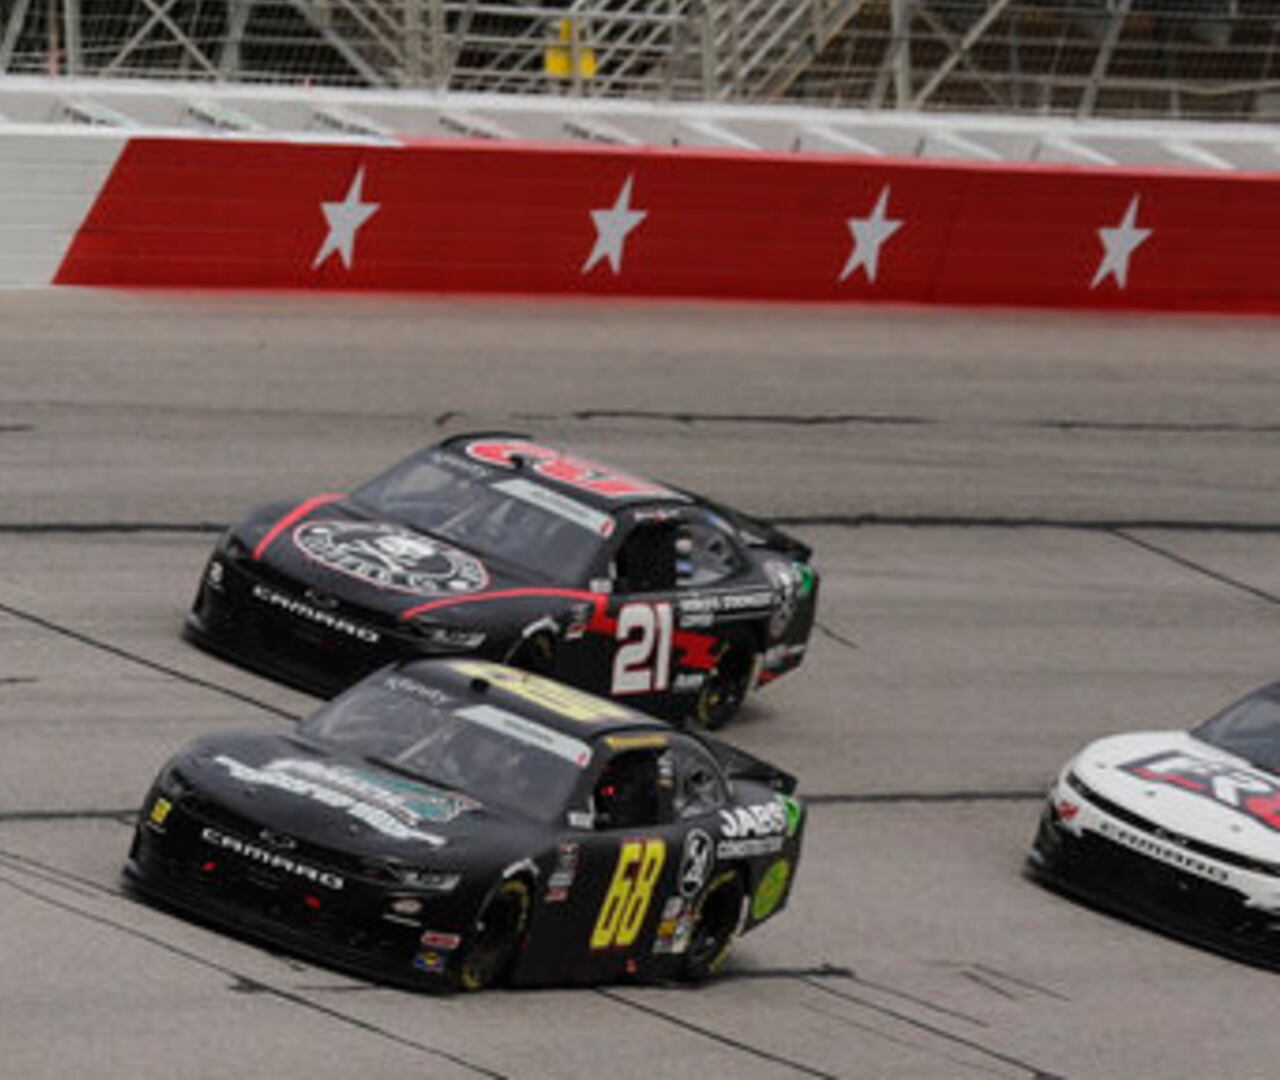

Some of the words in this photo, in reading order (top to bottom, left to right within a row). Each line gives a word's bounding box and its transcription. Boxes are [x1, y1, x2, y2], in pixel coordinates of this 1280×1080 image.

[611, 601, 675, 696] 21
[201, 827, 344, 890] CAMARO
[590, 838, 667, 951] 68
